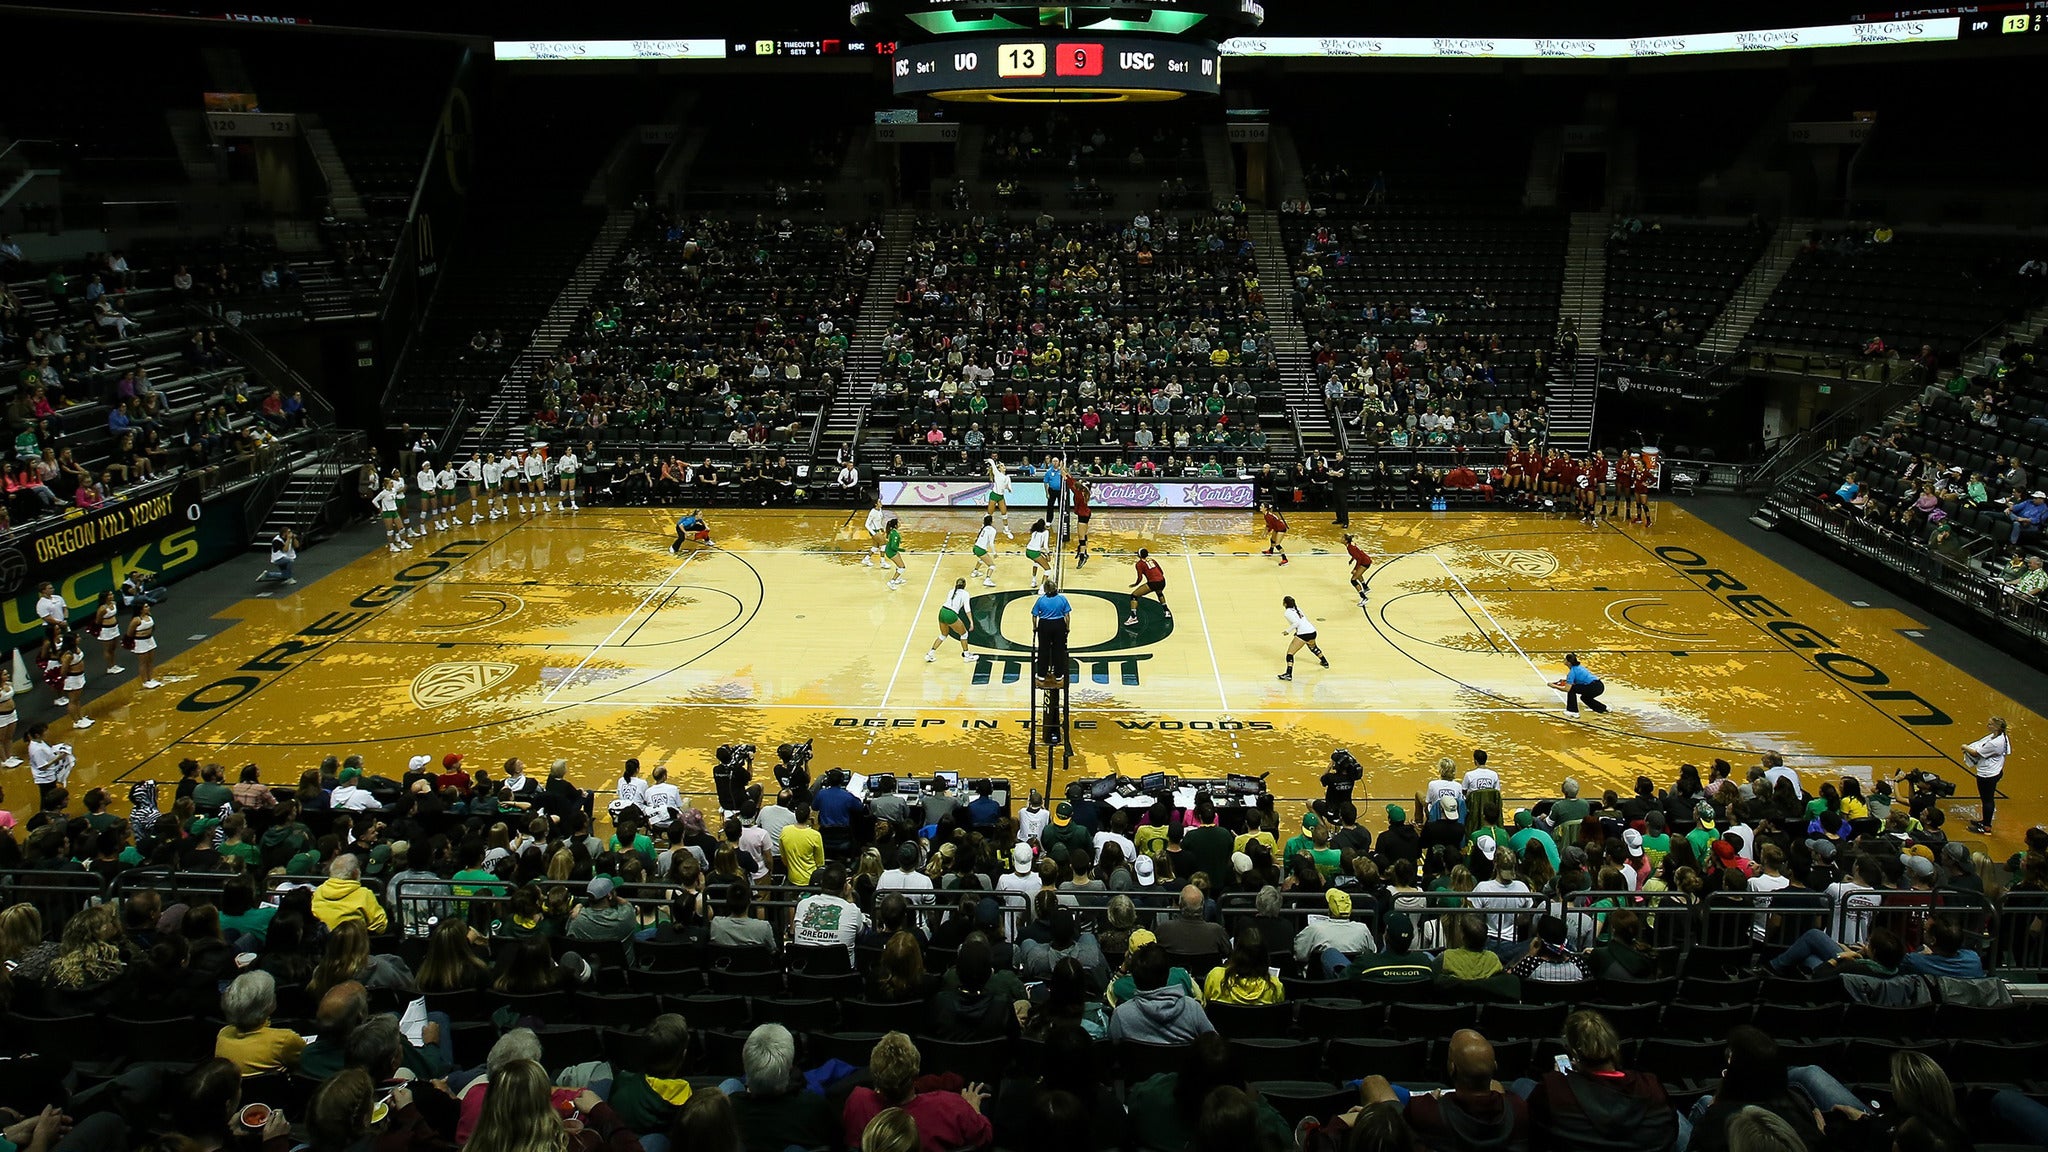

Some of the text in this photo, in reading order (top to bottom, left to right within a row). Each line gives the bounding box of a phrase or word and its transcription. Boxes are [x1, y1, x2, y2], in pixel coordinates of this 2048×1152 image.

[2007, 18, 2025, 30] 13
[759, 44, 771, 53] 13
[916, 61, 929, 73] Set
[955, 53, 977, 71] UO
[1009, 48, 1035, 70] 13
[1073, 49, 1087, 69] 9
[1120, 51, 1155, 71] USC
[1168, 60, 1183, 73] Set
[1202, 59, 1213, 76] UO
[214, 121, 235, 130] 120
[880, 130, 894, 138] 102
[242, 310, 304, 321] NETWORKS
[1630, 382, 1682, 394] NETWORKS
[1101, 485, 1135, 499] Carl's
[1198, 485, 1232, 501] Carl's
[35, 521, 97, 563] OREGON
[99, 511, 130, 540] KILL
[176, 539, 489, 712] OREGON
[1654, 545, 1953, 726] OREGON
[834, 717, 1273, 730] DEEP IN TE WOODS
[803, 929, 834, 939] OREGON
[1383, 969, 1420, 977] OREGON
